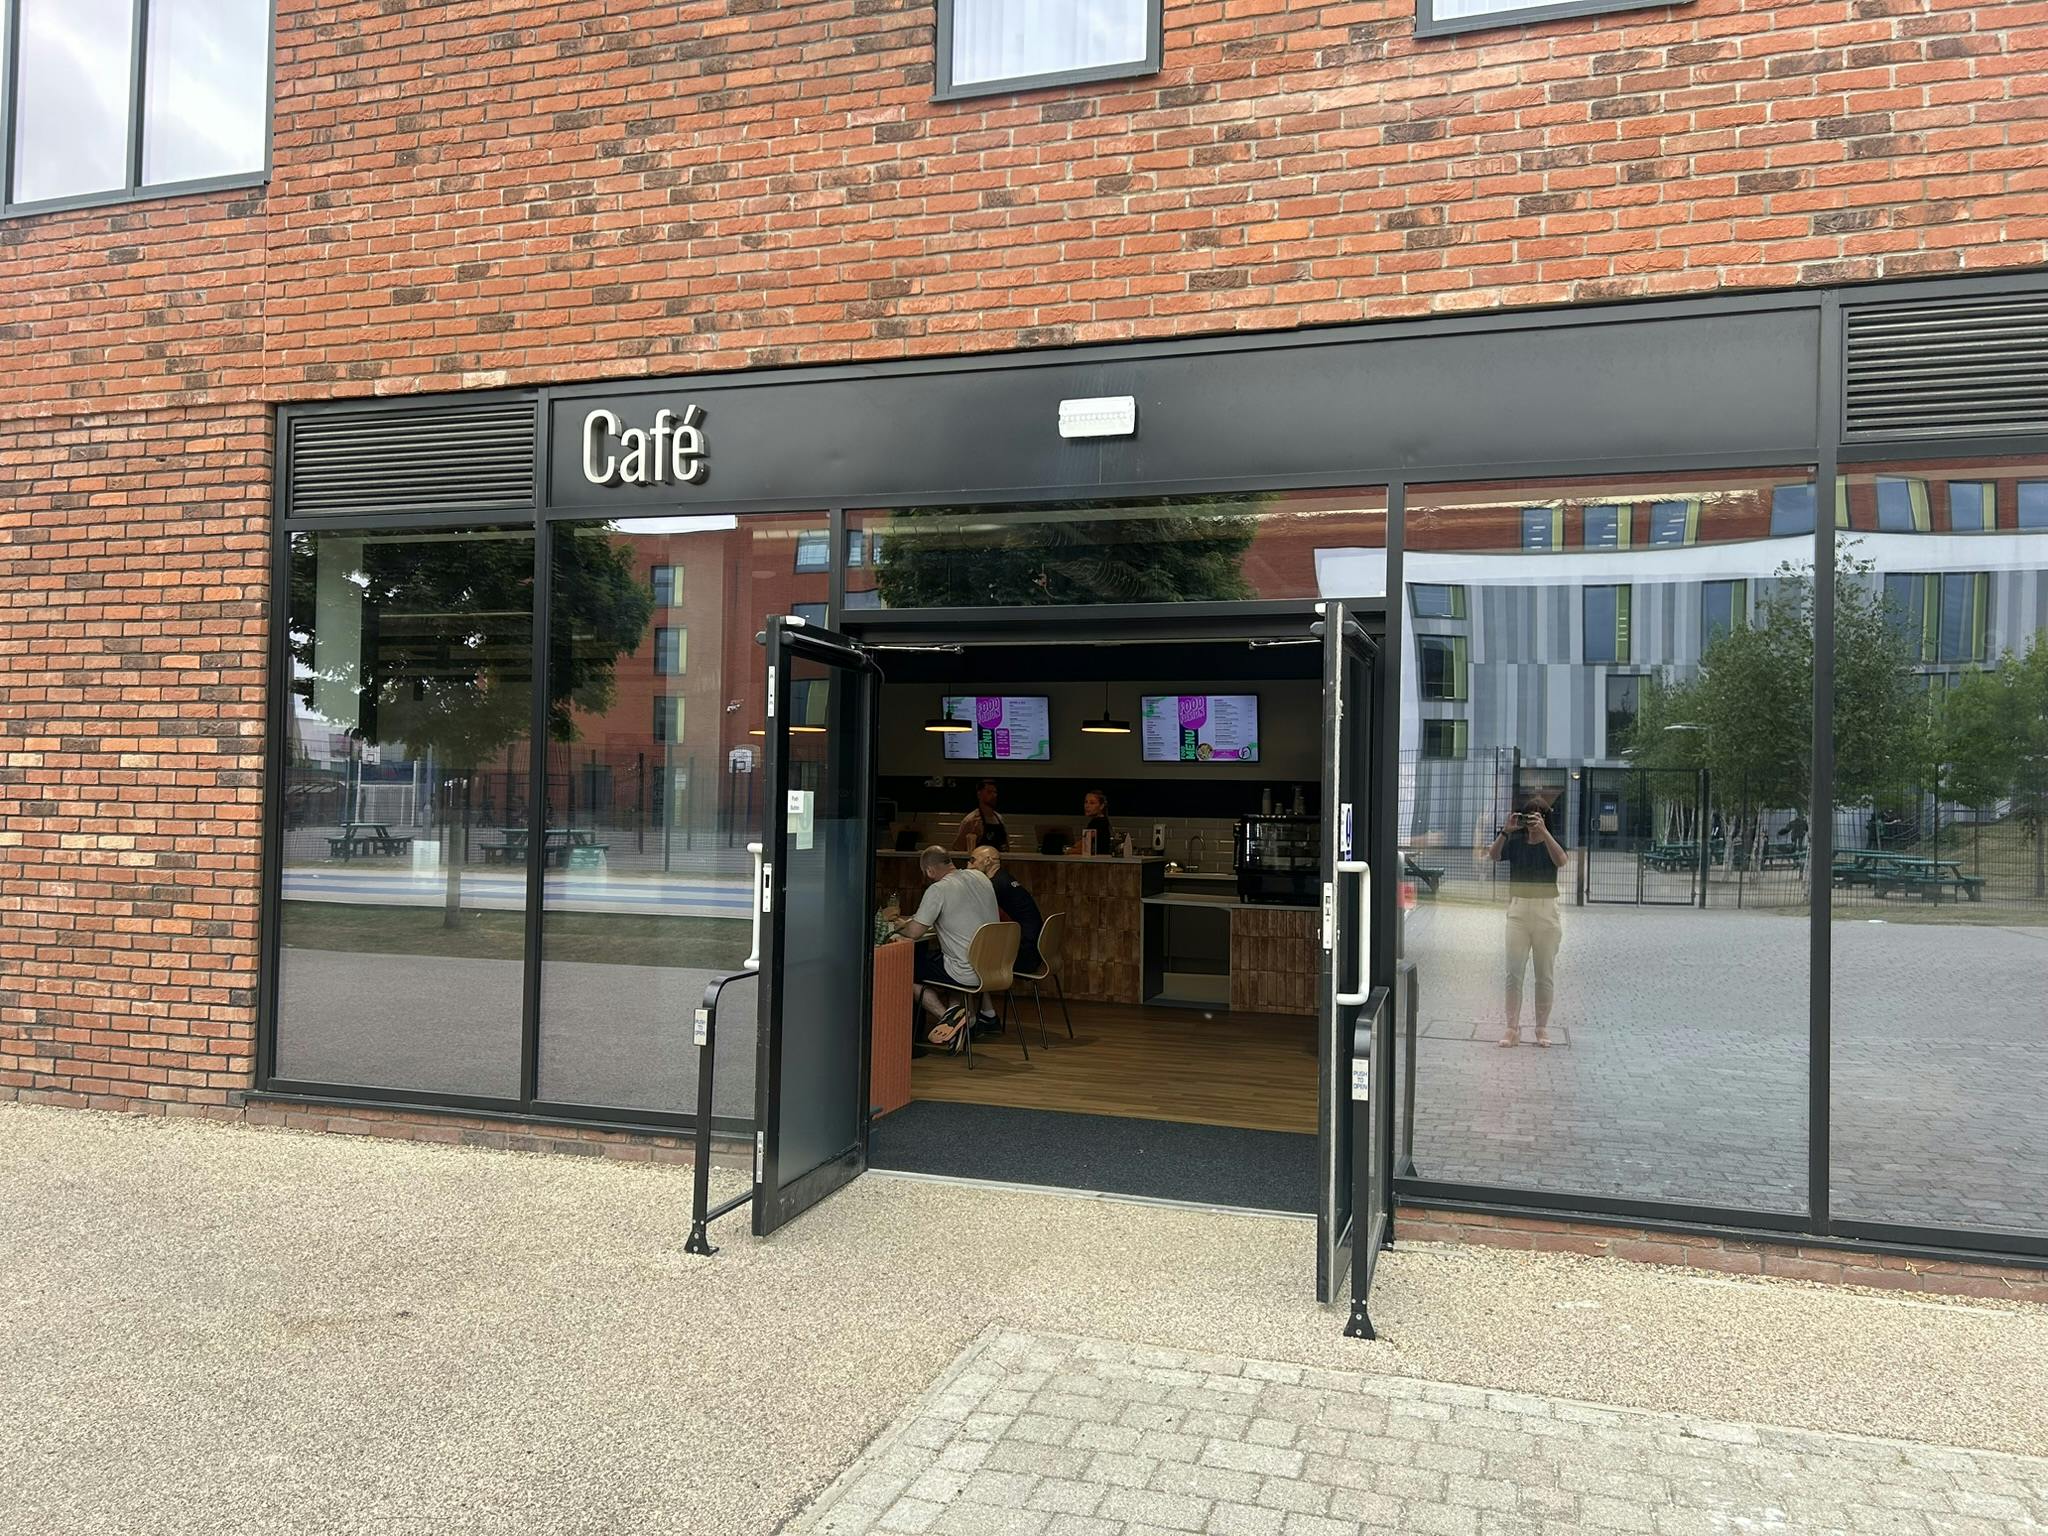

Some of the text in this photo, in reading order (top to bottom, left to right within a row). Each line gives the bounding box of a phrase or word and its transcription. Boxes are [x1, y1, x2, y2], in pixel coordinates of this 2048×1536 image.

[583, 404, 702, 484] Café
[983, 729, 993, 758] MENU
[1185, 730, 1195, 759] MENU
